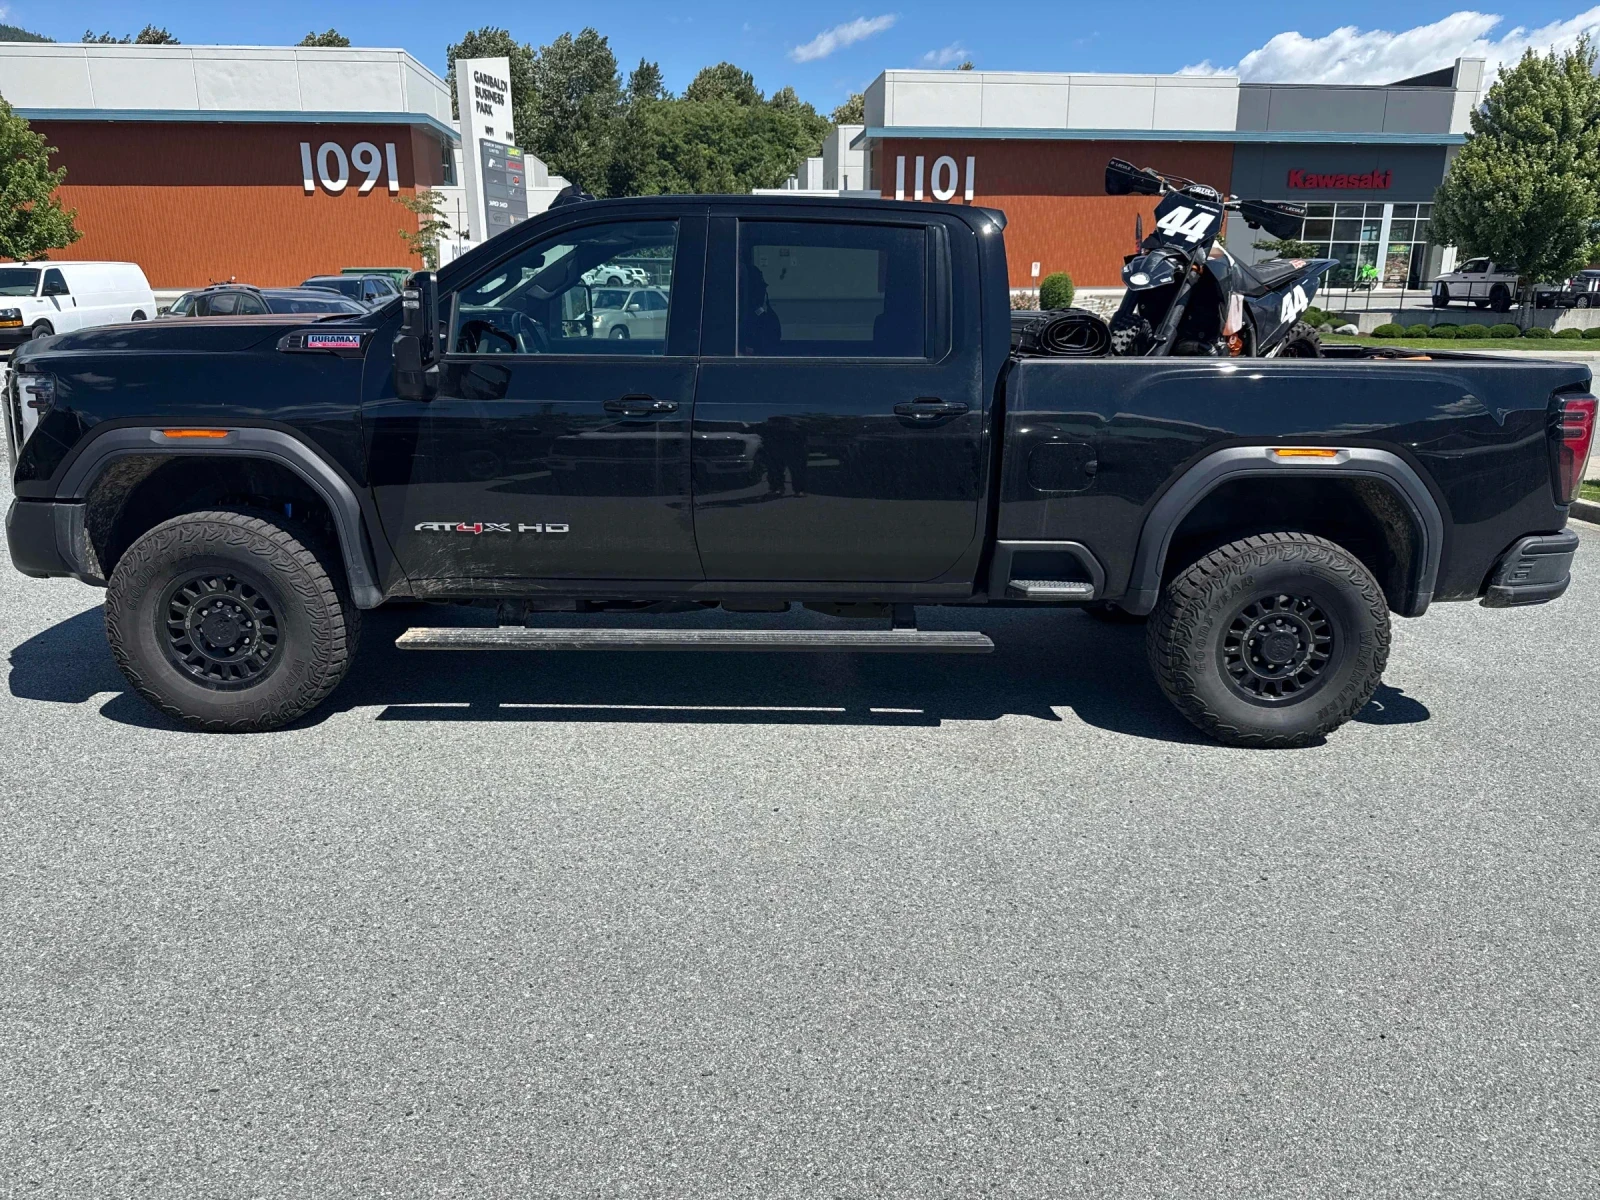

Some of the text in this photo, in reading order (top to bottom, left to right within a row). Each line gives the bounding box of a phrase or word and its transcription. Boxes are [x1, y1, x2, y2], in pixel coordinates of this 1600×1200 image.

[473, 70, 508, 93] GARIBALDI
[475, 85, 505, 106] BUSINESS
[476, 100, 493, 117] PARK
[300, 141, 399, 191] 1091
[895, 155, 975, 201] 1101
[1288, 169, 1393, 189] Kawasaki
[1156, 205, 1216, 243] 44
[1281, 284, 1309, 324] 44
[311, 335, 357, 343] DURAMAX
[414, 521, 570, 535] AT4X HD
